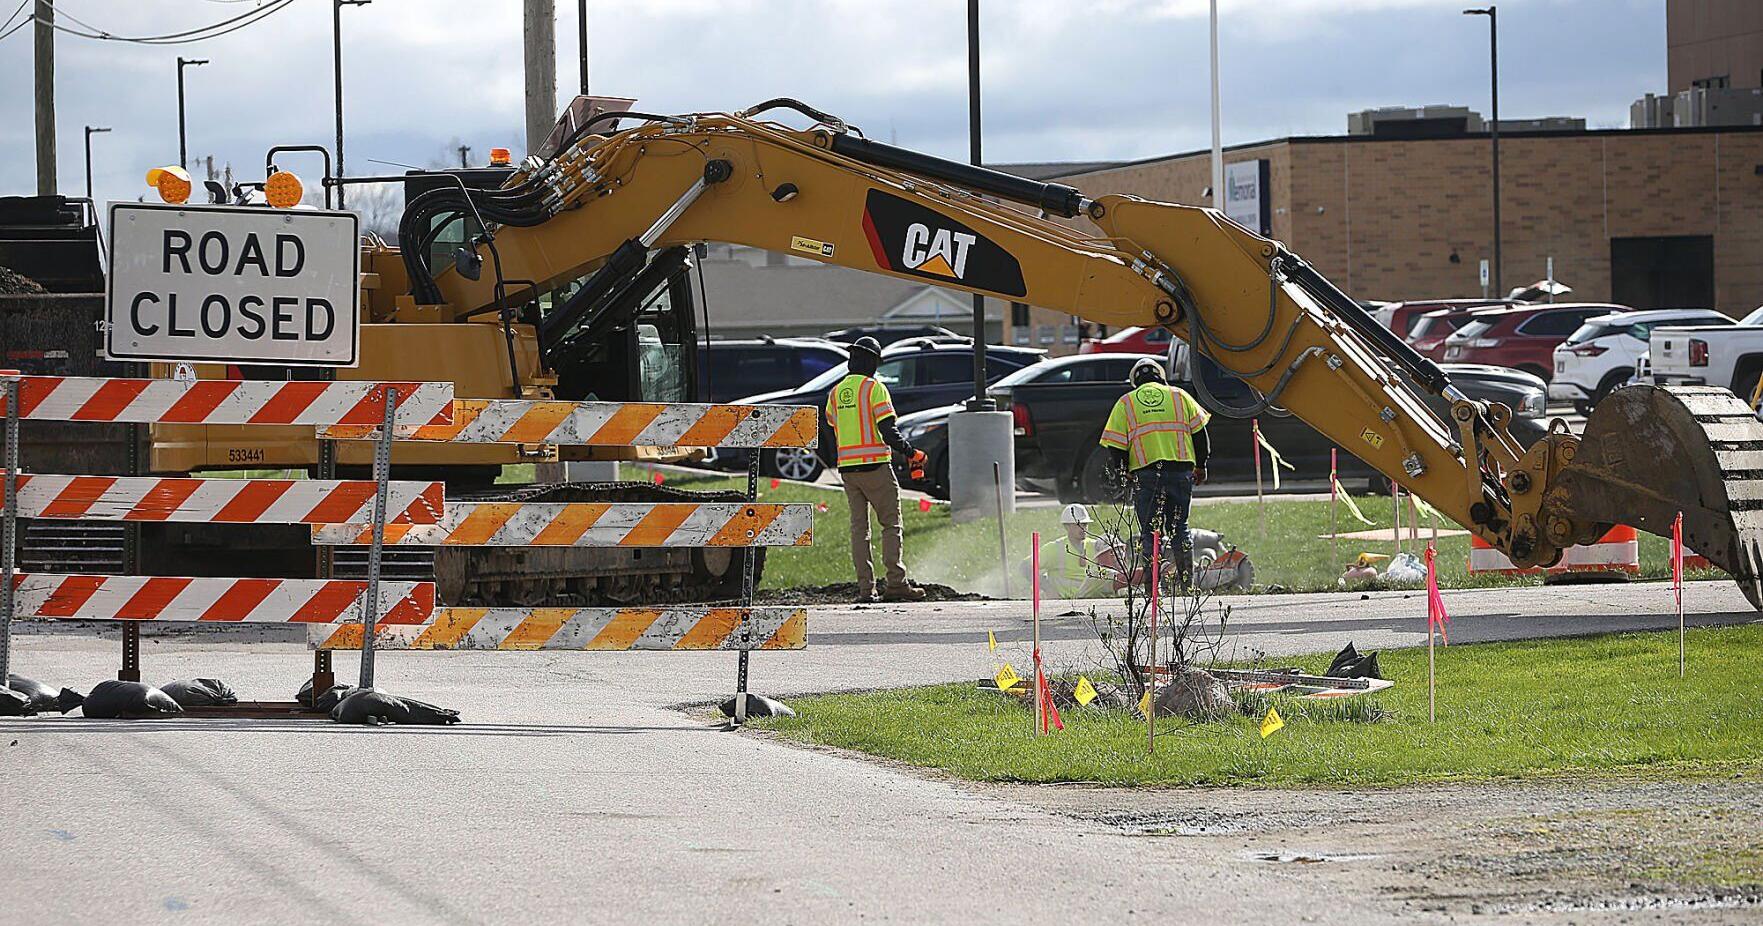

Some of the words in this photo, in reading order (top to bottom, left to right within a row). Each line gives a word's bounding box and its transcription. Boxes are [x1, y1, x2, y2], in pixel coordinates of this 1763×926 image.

[162, 229, 305, 278] ROAD
[903, 223, 977, 279] CAT
[130, 291, 335, 341] CLOSED
[229, 448, 265, 462] 533441
